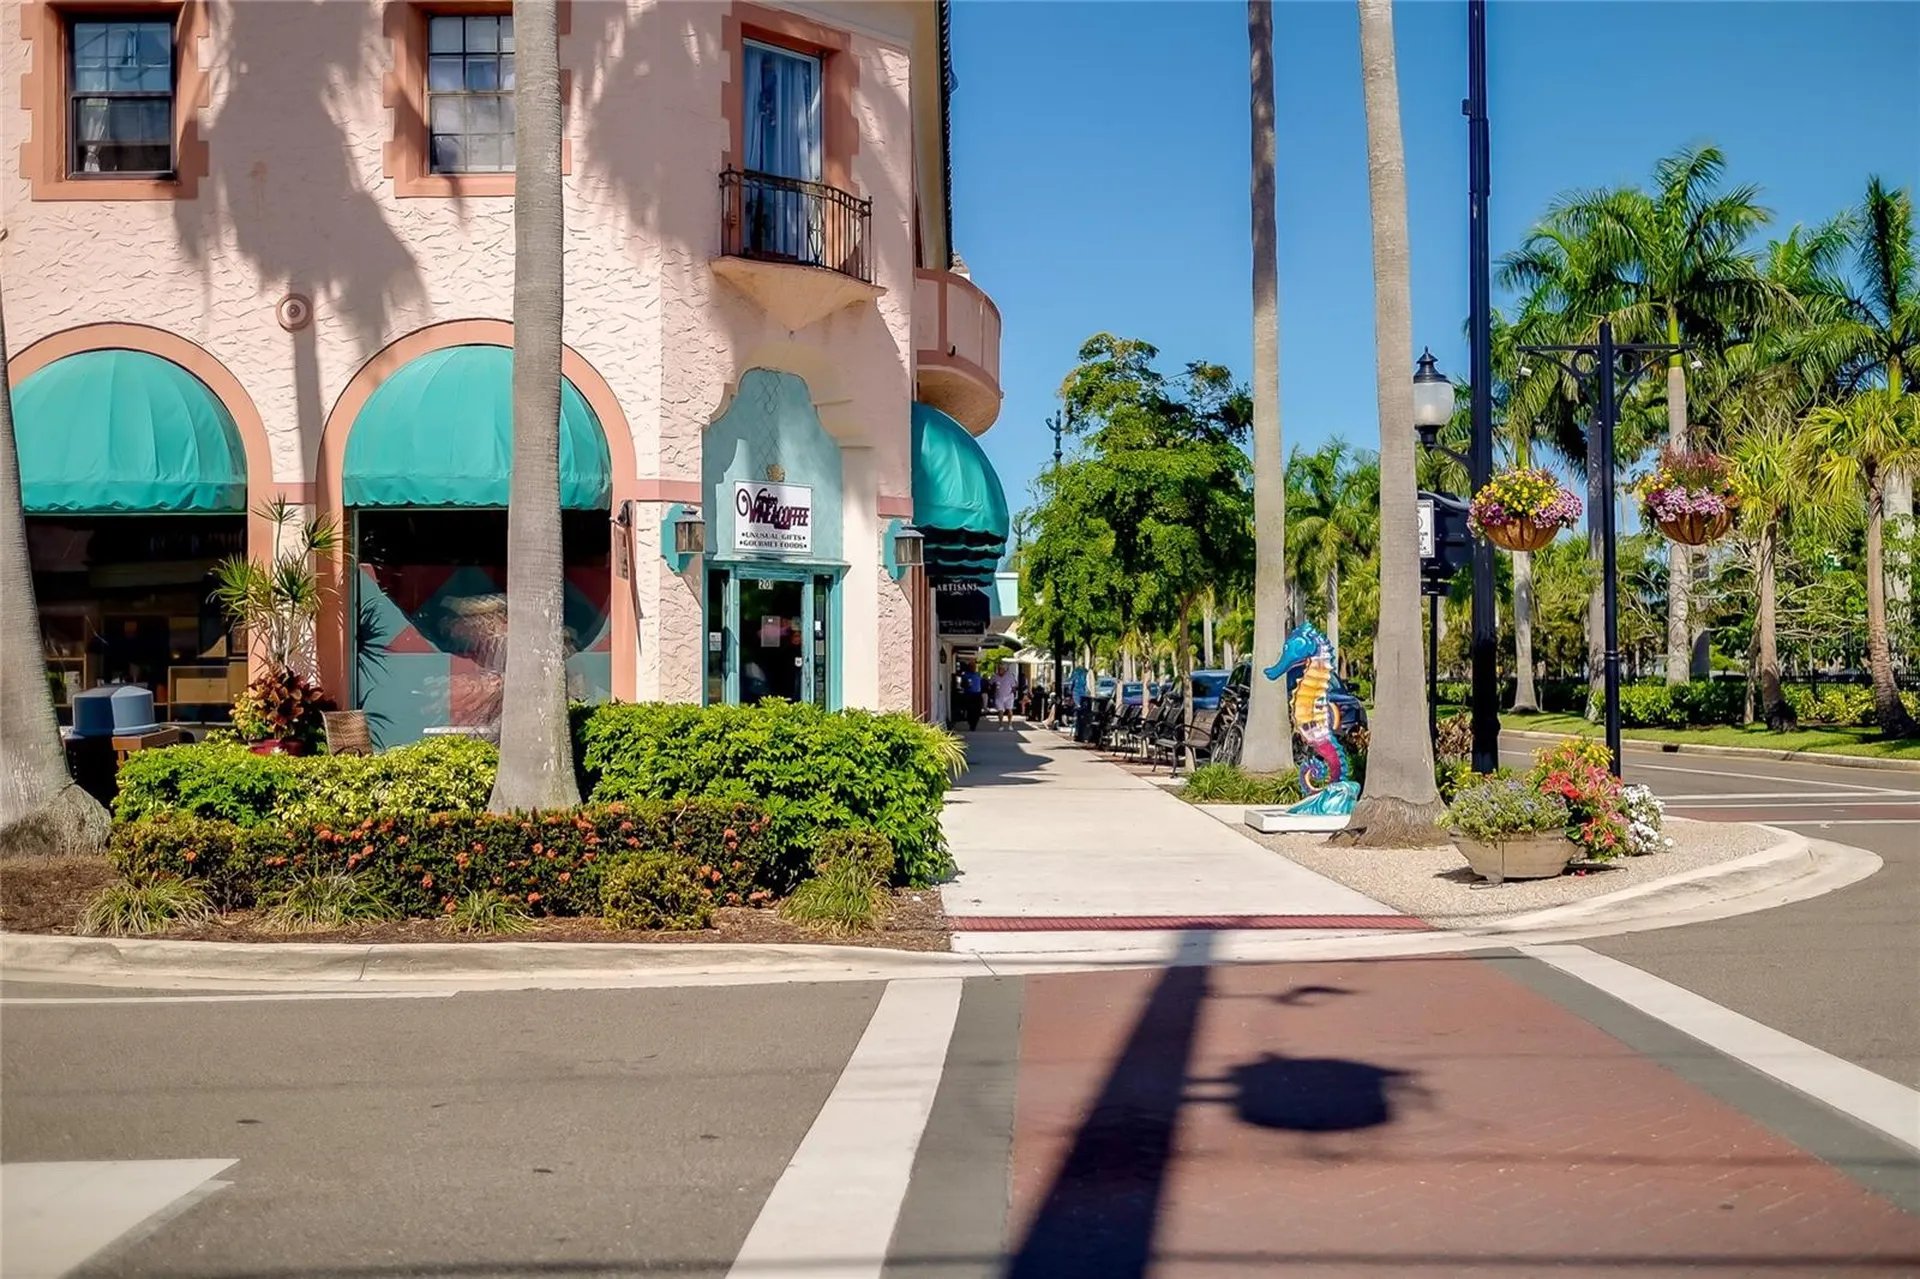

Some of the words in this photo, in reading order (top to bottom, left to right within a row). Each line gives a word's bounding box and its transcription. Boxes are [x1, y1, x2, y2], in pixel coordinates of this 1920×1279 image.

[745, 531, 779, 540] UNUSUAL
[781, 533, 802, 541] GIFTS
[743, 540, 778, 548] GOURMET
[936, 583, 977, 591] ARTISANS
